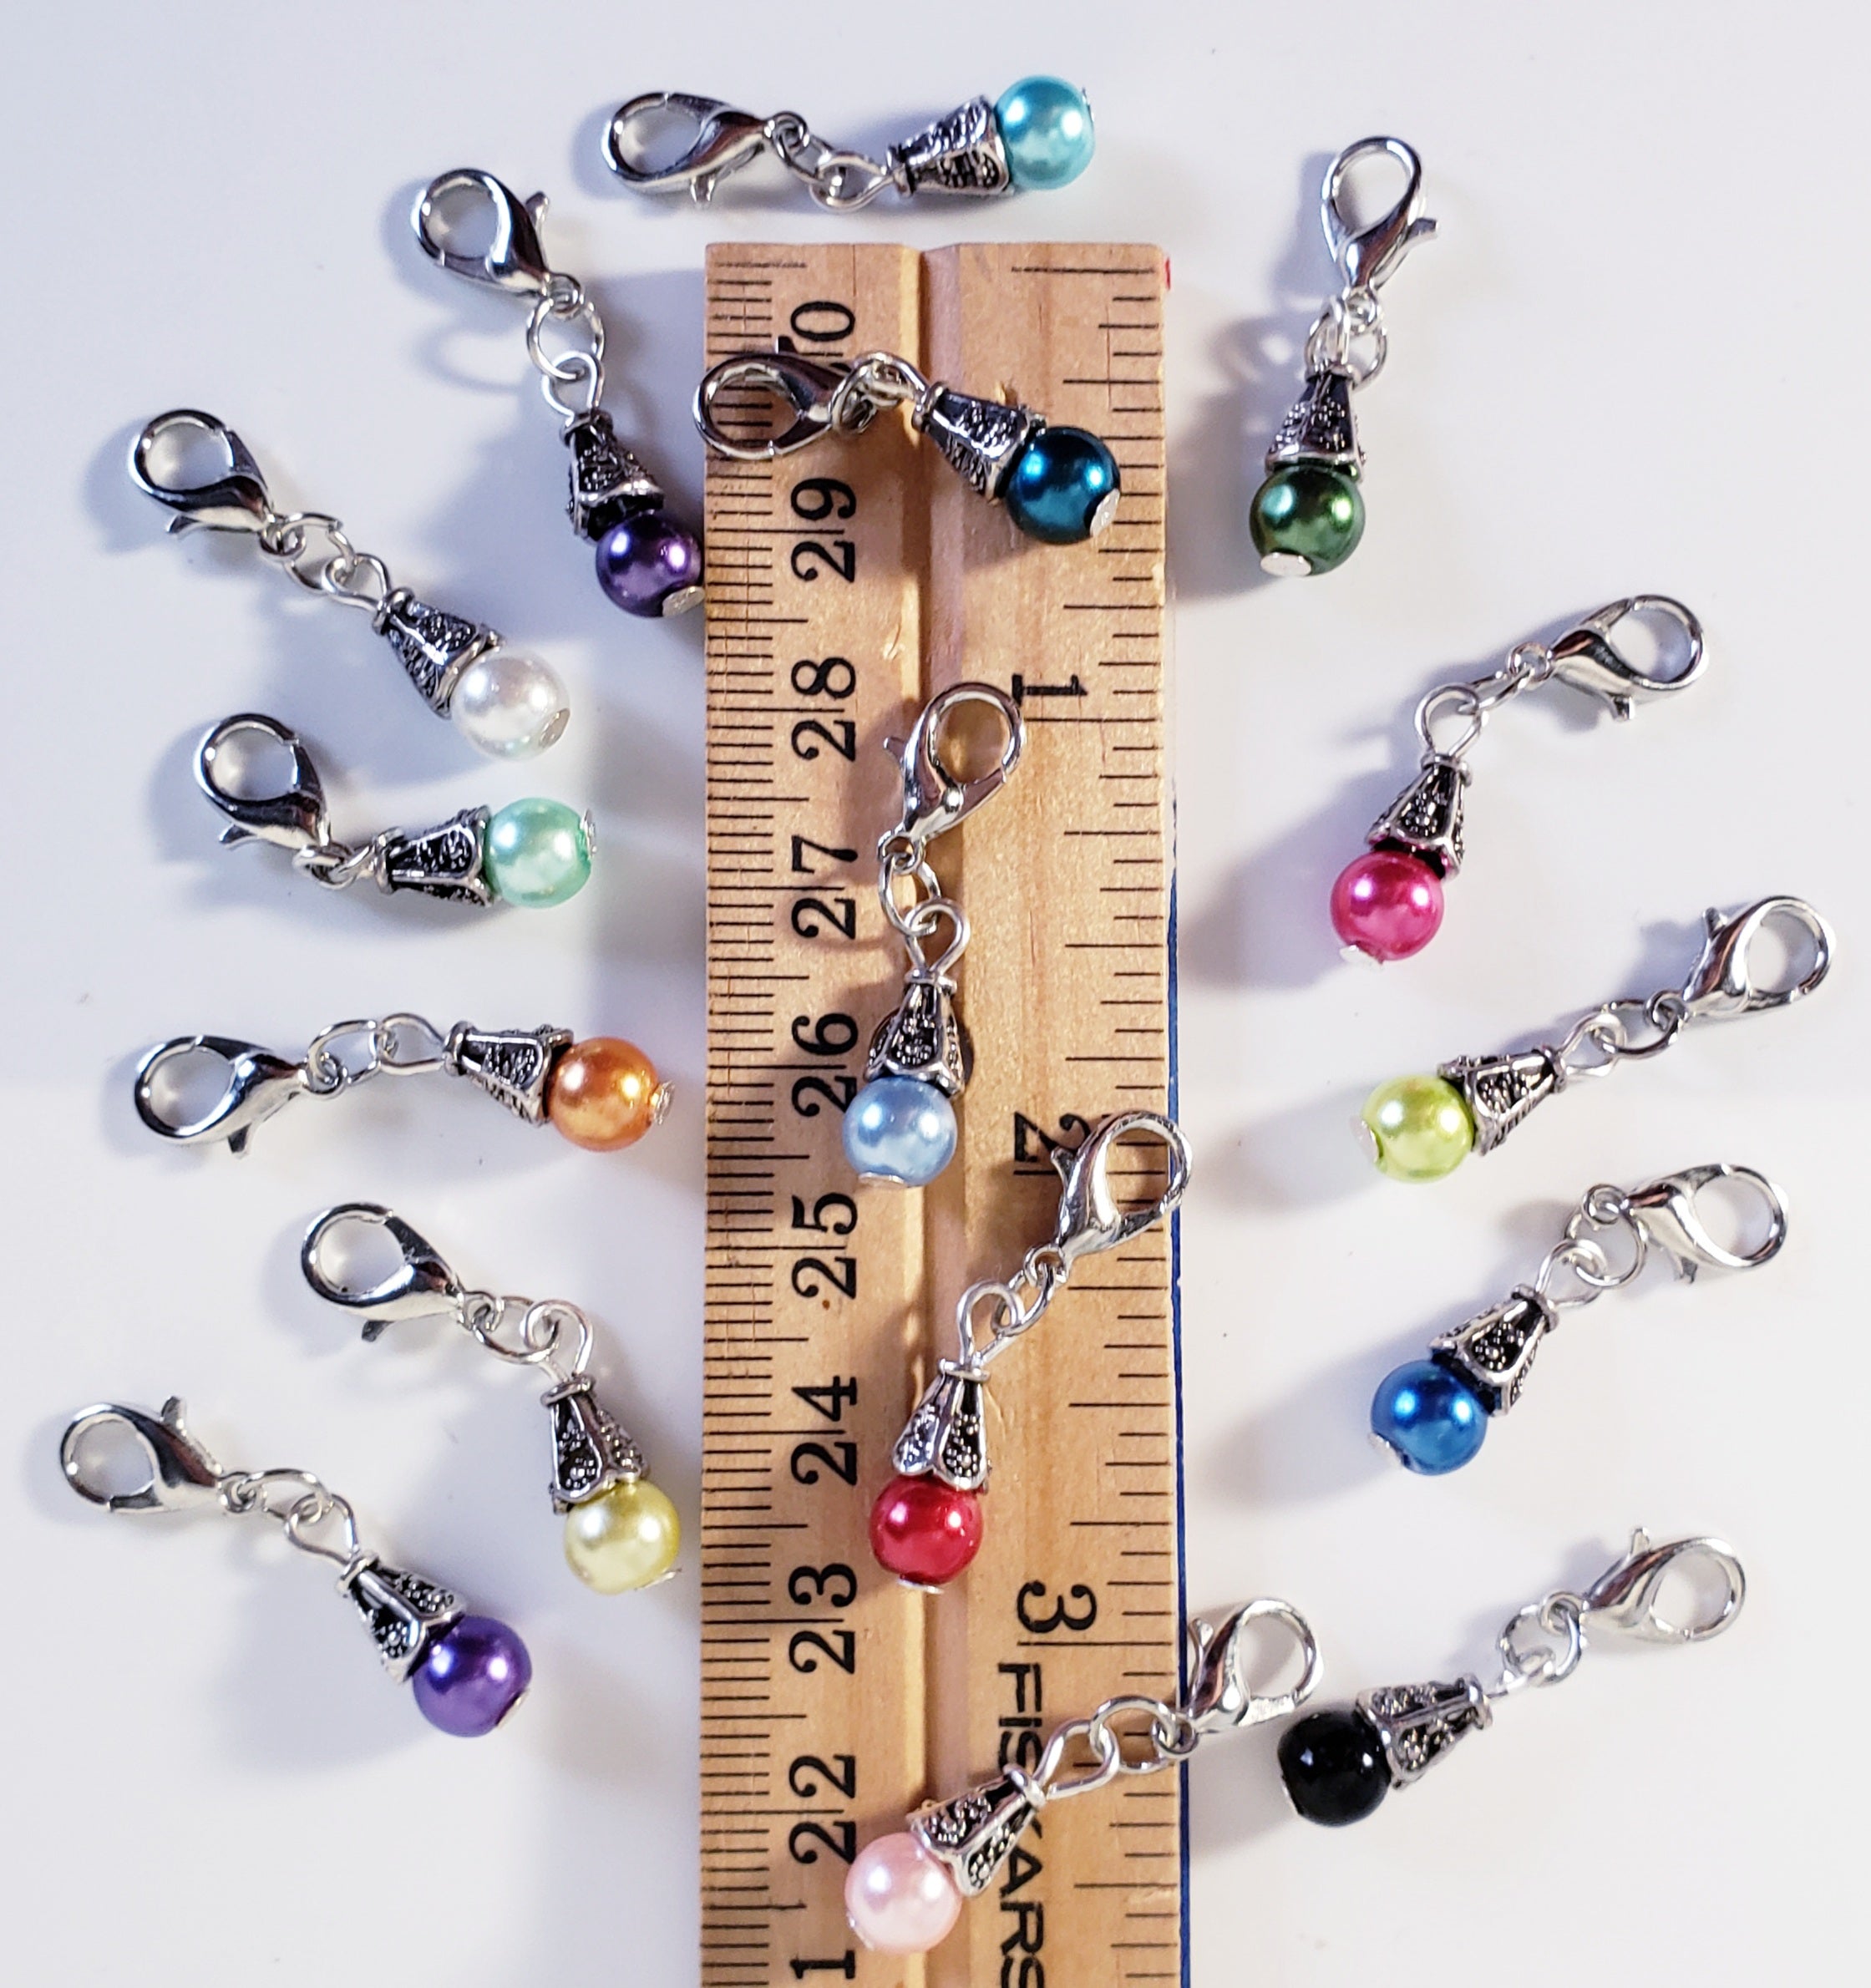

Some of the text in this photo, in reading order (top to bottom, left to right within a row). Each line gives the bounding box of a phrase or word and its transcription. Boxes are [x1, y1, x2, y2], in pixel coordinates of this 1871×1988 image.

[790, 302, 854, 373] 0
[790, 478, 857, 583] 29
[790, 657, 857, 762] 28
[1012, 673, 1088, 705] 1
[791, 834, 859, 941] 27
[791, 1013, 859, 1117] 26
[1014, 1112, 1092, 1164] 2
[791, 1192, 859, 1299] 25
[791, 1375, 858, 1486] 24
[788, 1562, 858, 1674] 23
[1017, 1580, 1098, 1634] 3
[788, 1754, 857, 1865] 22
[997, 1661, 1045, 1988] FISARS
